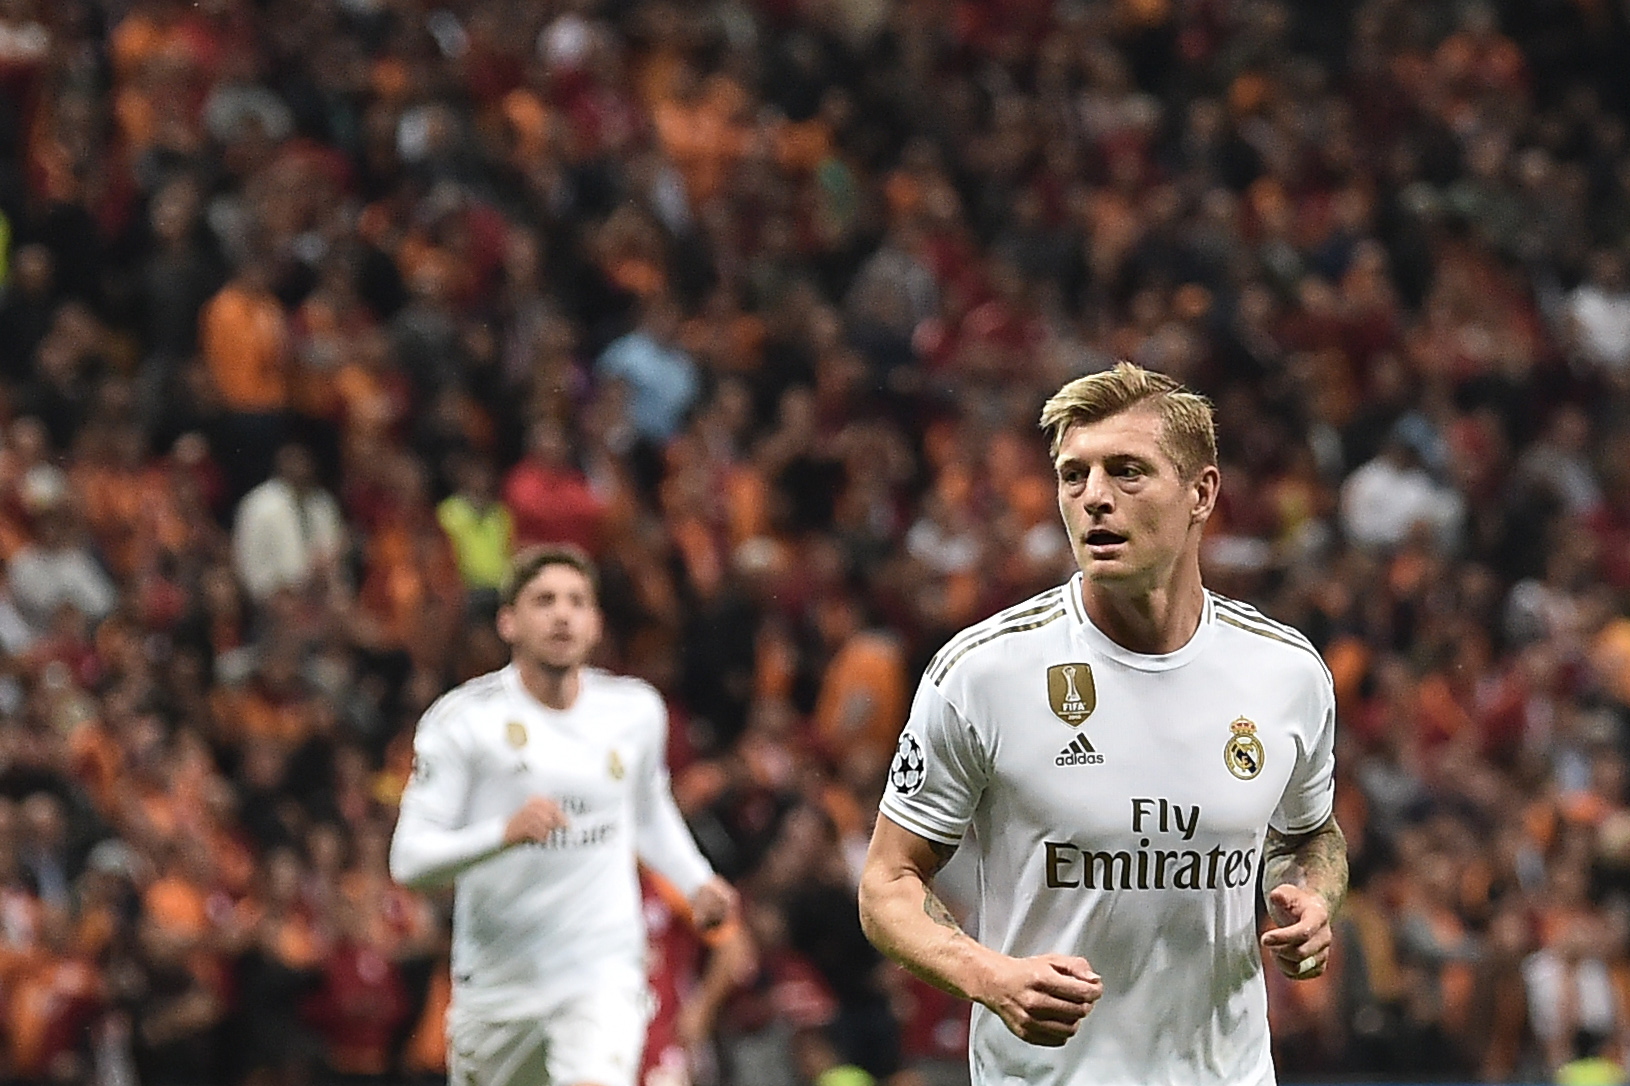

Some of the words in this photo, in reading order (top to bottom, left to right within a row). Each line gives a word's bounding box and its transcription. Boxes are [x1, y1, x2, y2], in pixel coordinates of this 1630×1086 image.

[1062, 702, 1085, 712] FIFA
[1055, 752, 1104, 766] adidas
[1131, 798, 1200, 841] Fly
[1044, 838, 1256, 891] Emirates
